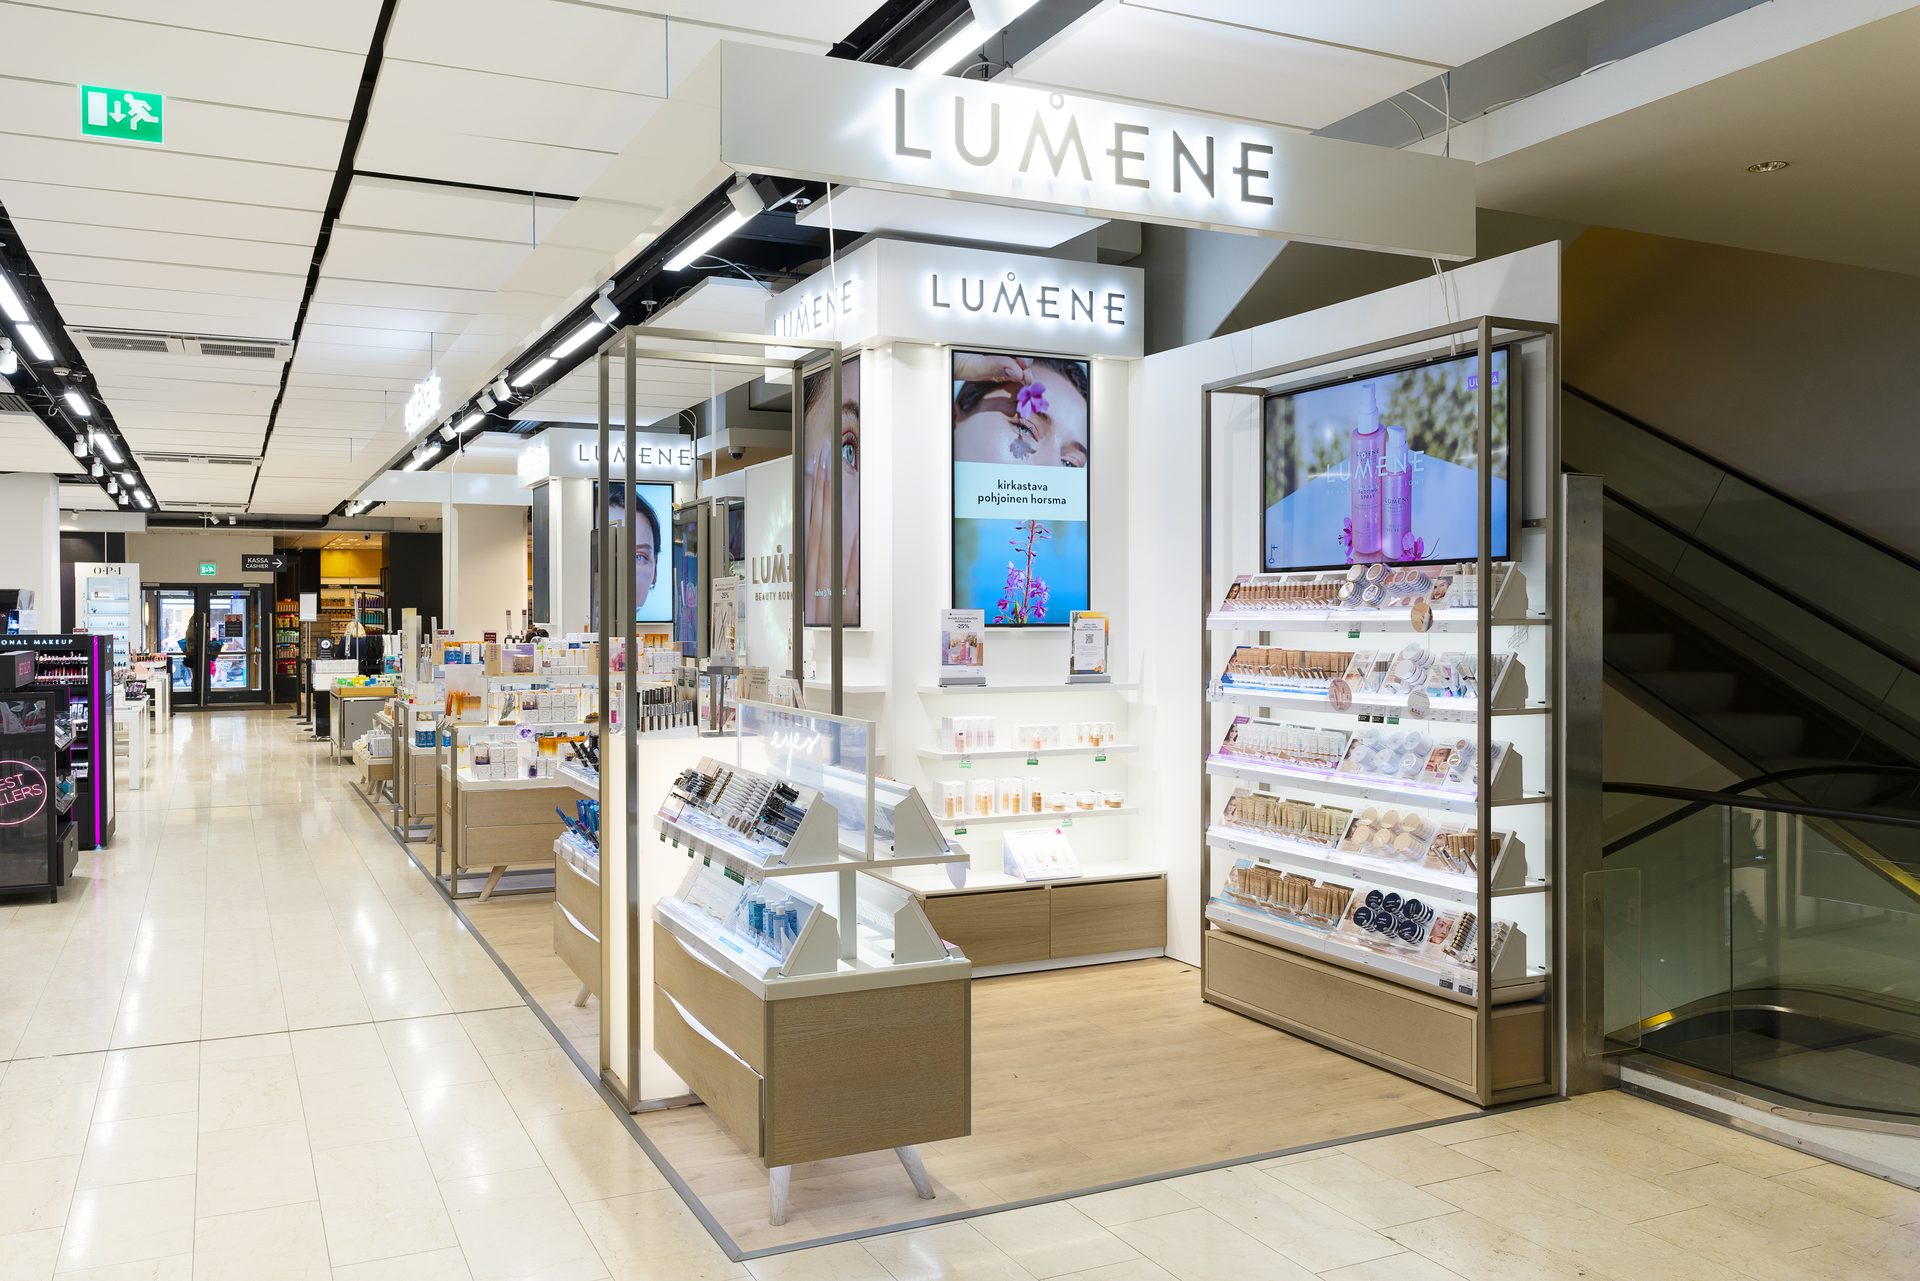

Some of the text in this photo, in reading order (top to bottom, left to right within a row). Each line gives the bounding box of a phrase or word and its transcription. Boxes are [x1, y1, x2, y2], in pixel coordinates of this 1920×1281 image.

[894, 88, 1274, 206] LUMENE
[931, 272, 1126, 326] LUMENE
[977, 492, 1067, 505] pohjoinen horsma
[997, 479, 1048, 492] kirkastava
[755, 591, 777, 601] BEAUTY
[770, 724, 821, 776] eyes
